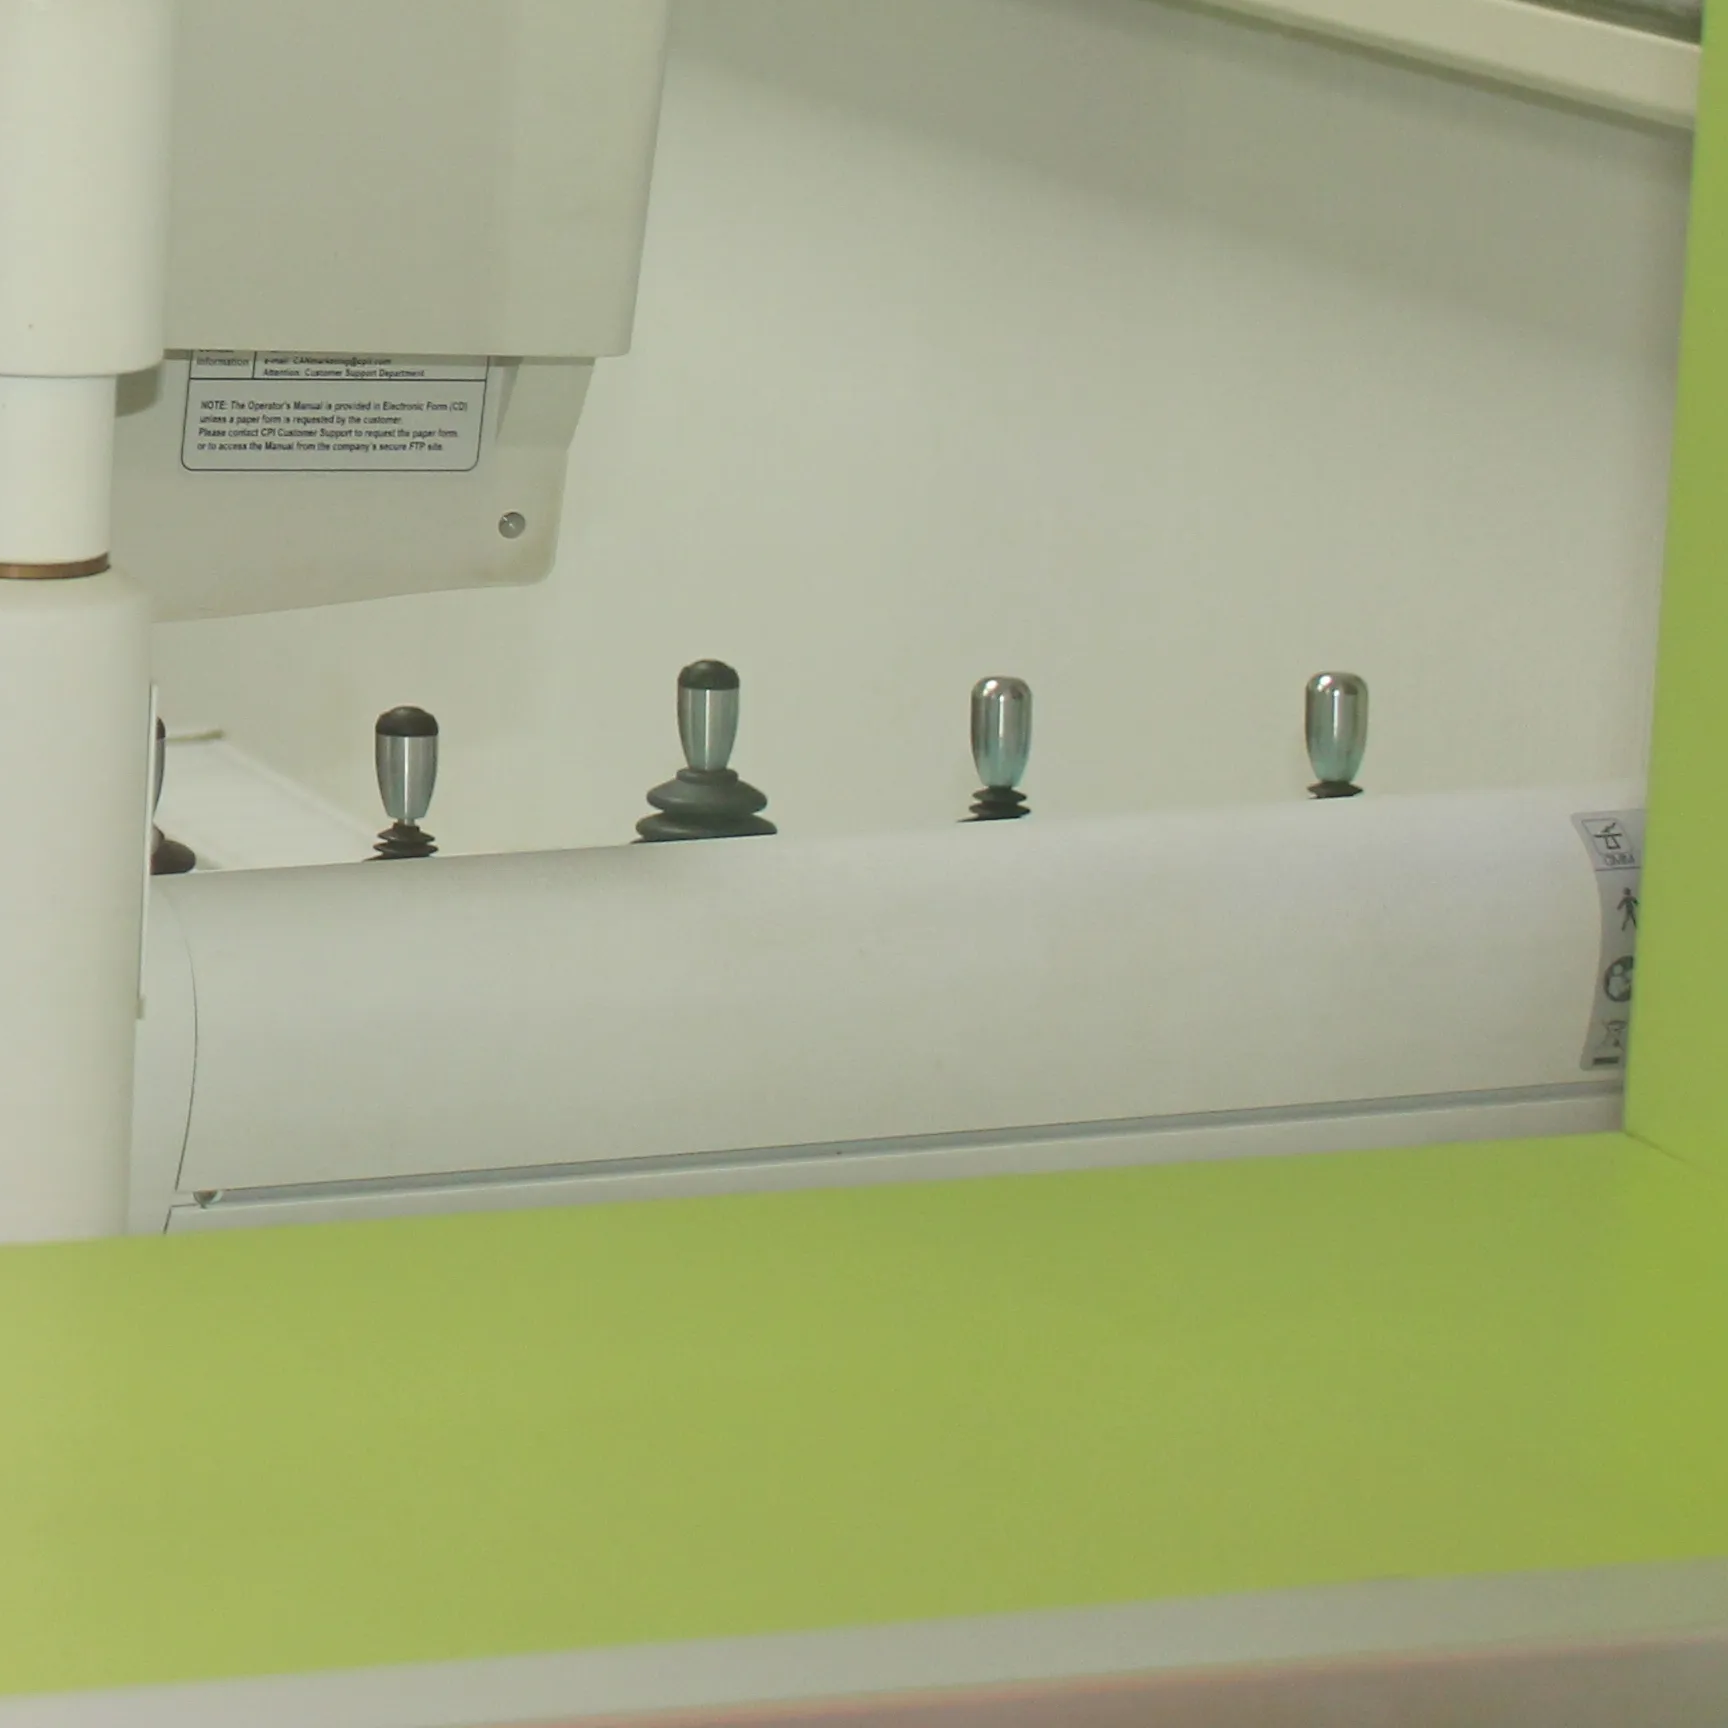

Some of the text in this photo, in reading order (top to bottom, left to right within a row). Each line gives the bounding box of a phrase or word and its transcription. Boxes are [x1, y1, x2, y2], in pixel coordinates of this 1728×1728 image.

[196, 356, 250, 366] Information
[231, 400, 246, 410] The
[248, 400, 291, 412] Operator's
[293, 401, 323, 410] Manual
[334, 401, 372, 413] provided
[382, 401, 425, 411] Electronic
[426, 401, 448, 411] Form
[199, 415, 227, 423] unless
[236, 416, 261, 426] paper
[262, 414, 283, 423] form
[293, 415, 335, 426] requested
[336, 415, 346, 427] by
[348, 415, 361, 424] the
[198, 427, 226, 437] Please
[228, 428, 259, 437] contact
[260, 428, 276, 437] CPI
[277, 428, 318, 438] Customer
[319, 428, 353, 439] Support
[364, 429, 396, 439] request
[397, 429, 410, 438] the
[412, 430, 436, 440] paper
[219, 442, 248, 450] access
[249, 440, 263, 450] the
[264, 440, 295, 450] Manual
[296, 440, 316, 450] from
[317, 440, 331, 450] the
[332, 442, 377, 454] company's
[379, 443, 408, 451] secure
[408, 441, 426, 451] FTP
